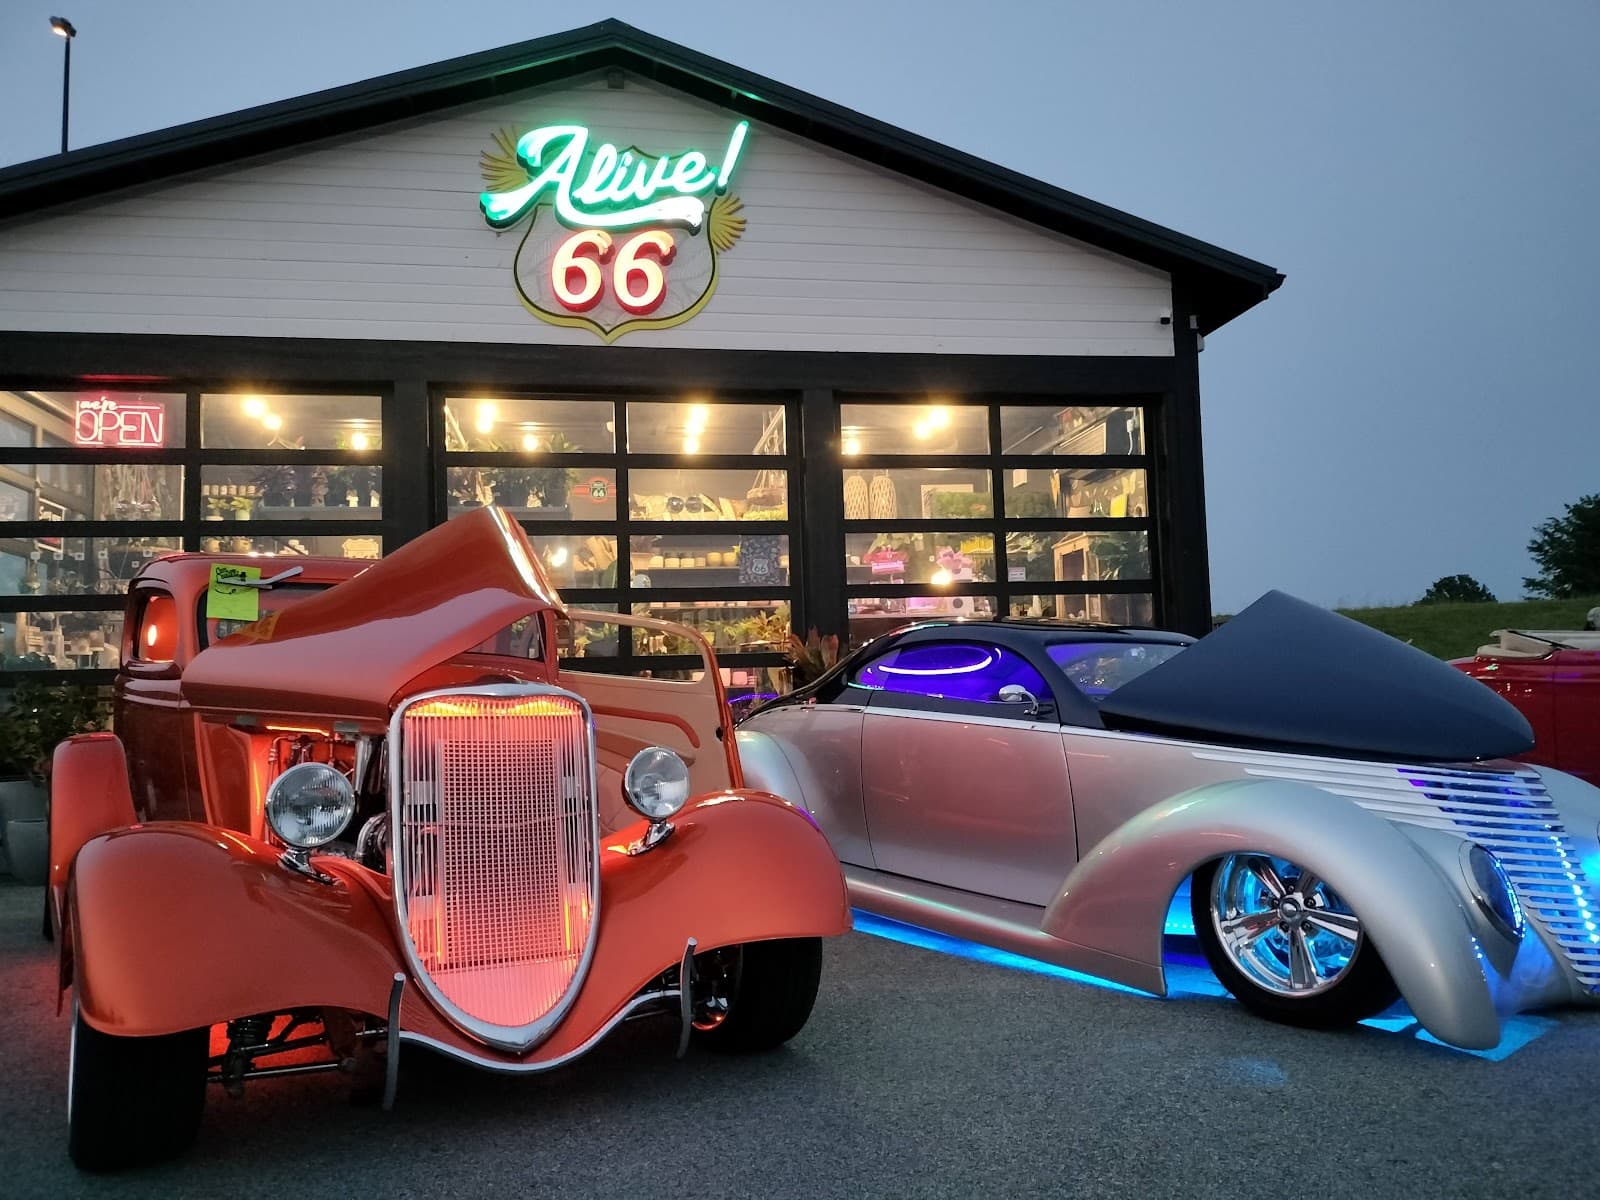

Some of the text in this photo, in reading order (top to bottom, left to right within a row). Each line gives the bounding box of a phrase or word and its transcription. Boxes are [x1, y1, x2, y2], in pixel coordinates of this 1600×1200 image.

[480, 120, 750, 237] Alive!
[551, 229, 677, 316] 66
[76, 408, 164, 443] OPEN
